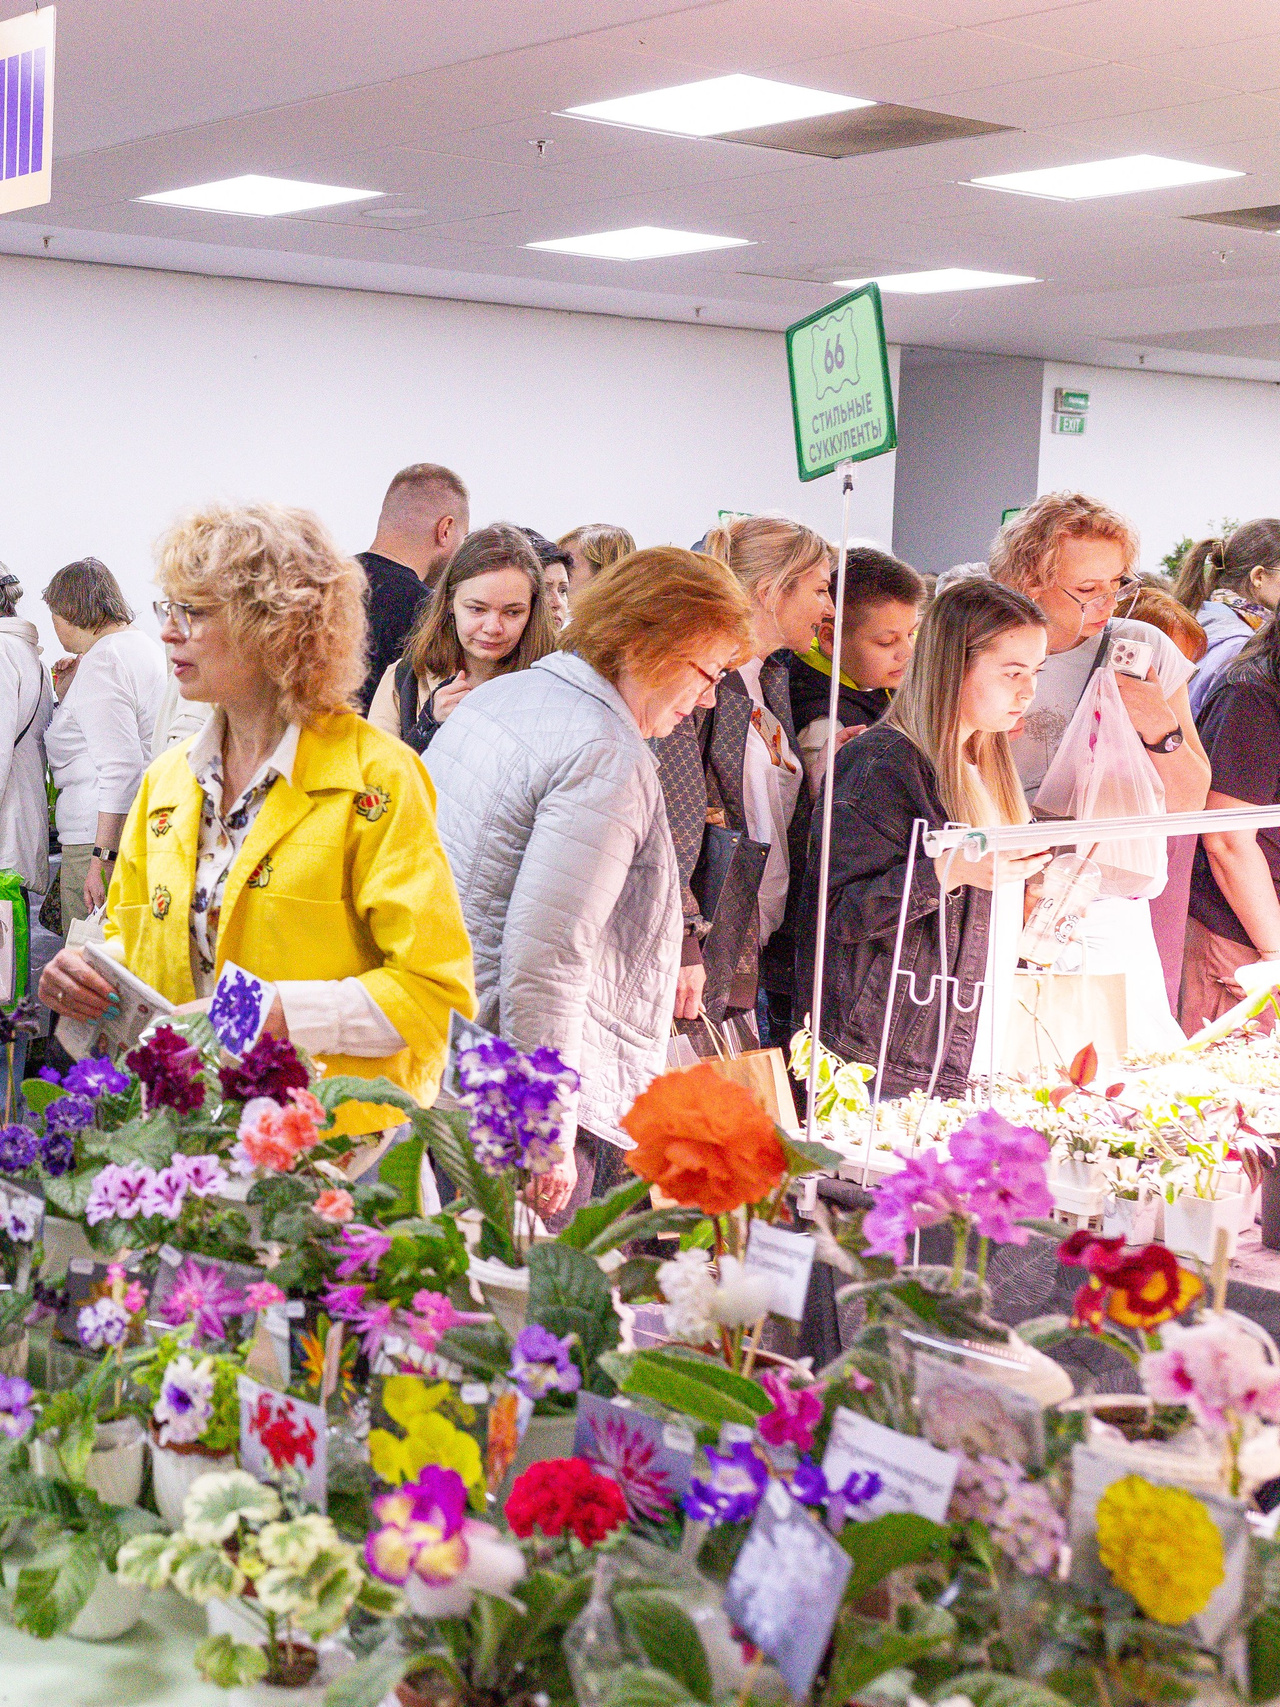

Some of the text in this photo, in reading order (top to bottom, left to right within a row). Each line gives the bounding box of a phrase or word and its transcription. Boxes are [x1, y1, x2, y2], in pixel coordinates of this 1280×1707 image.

[824, 333, 845, 374] 66
[811, 392, 873, 434] СТИЛЬНЫЕ
[1063, 417, 1081, 432] EXIT
[809, 418, 882, 463] СУККУЛЕНТЫ
